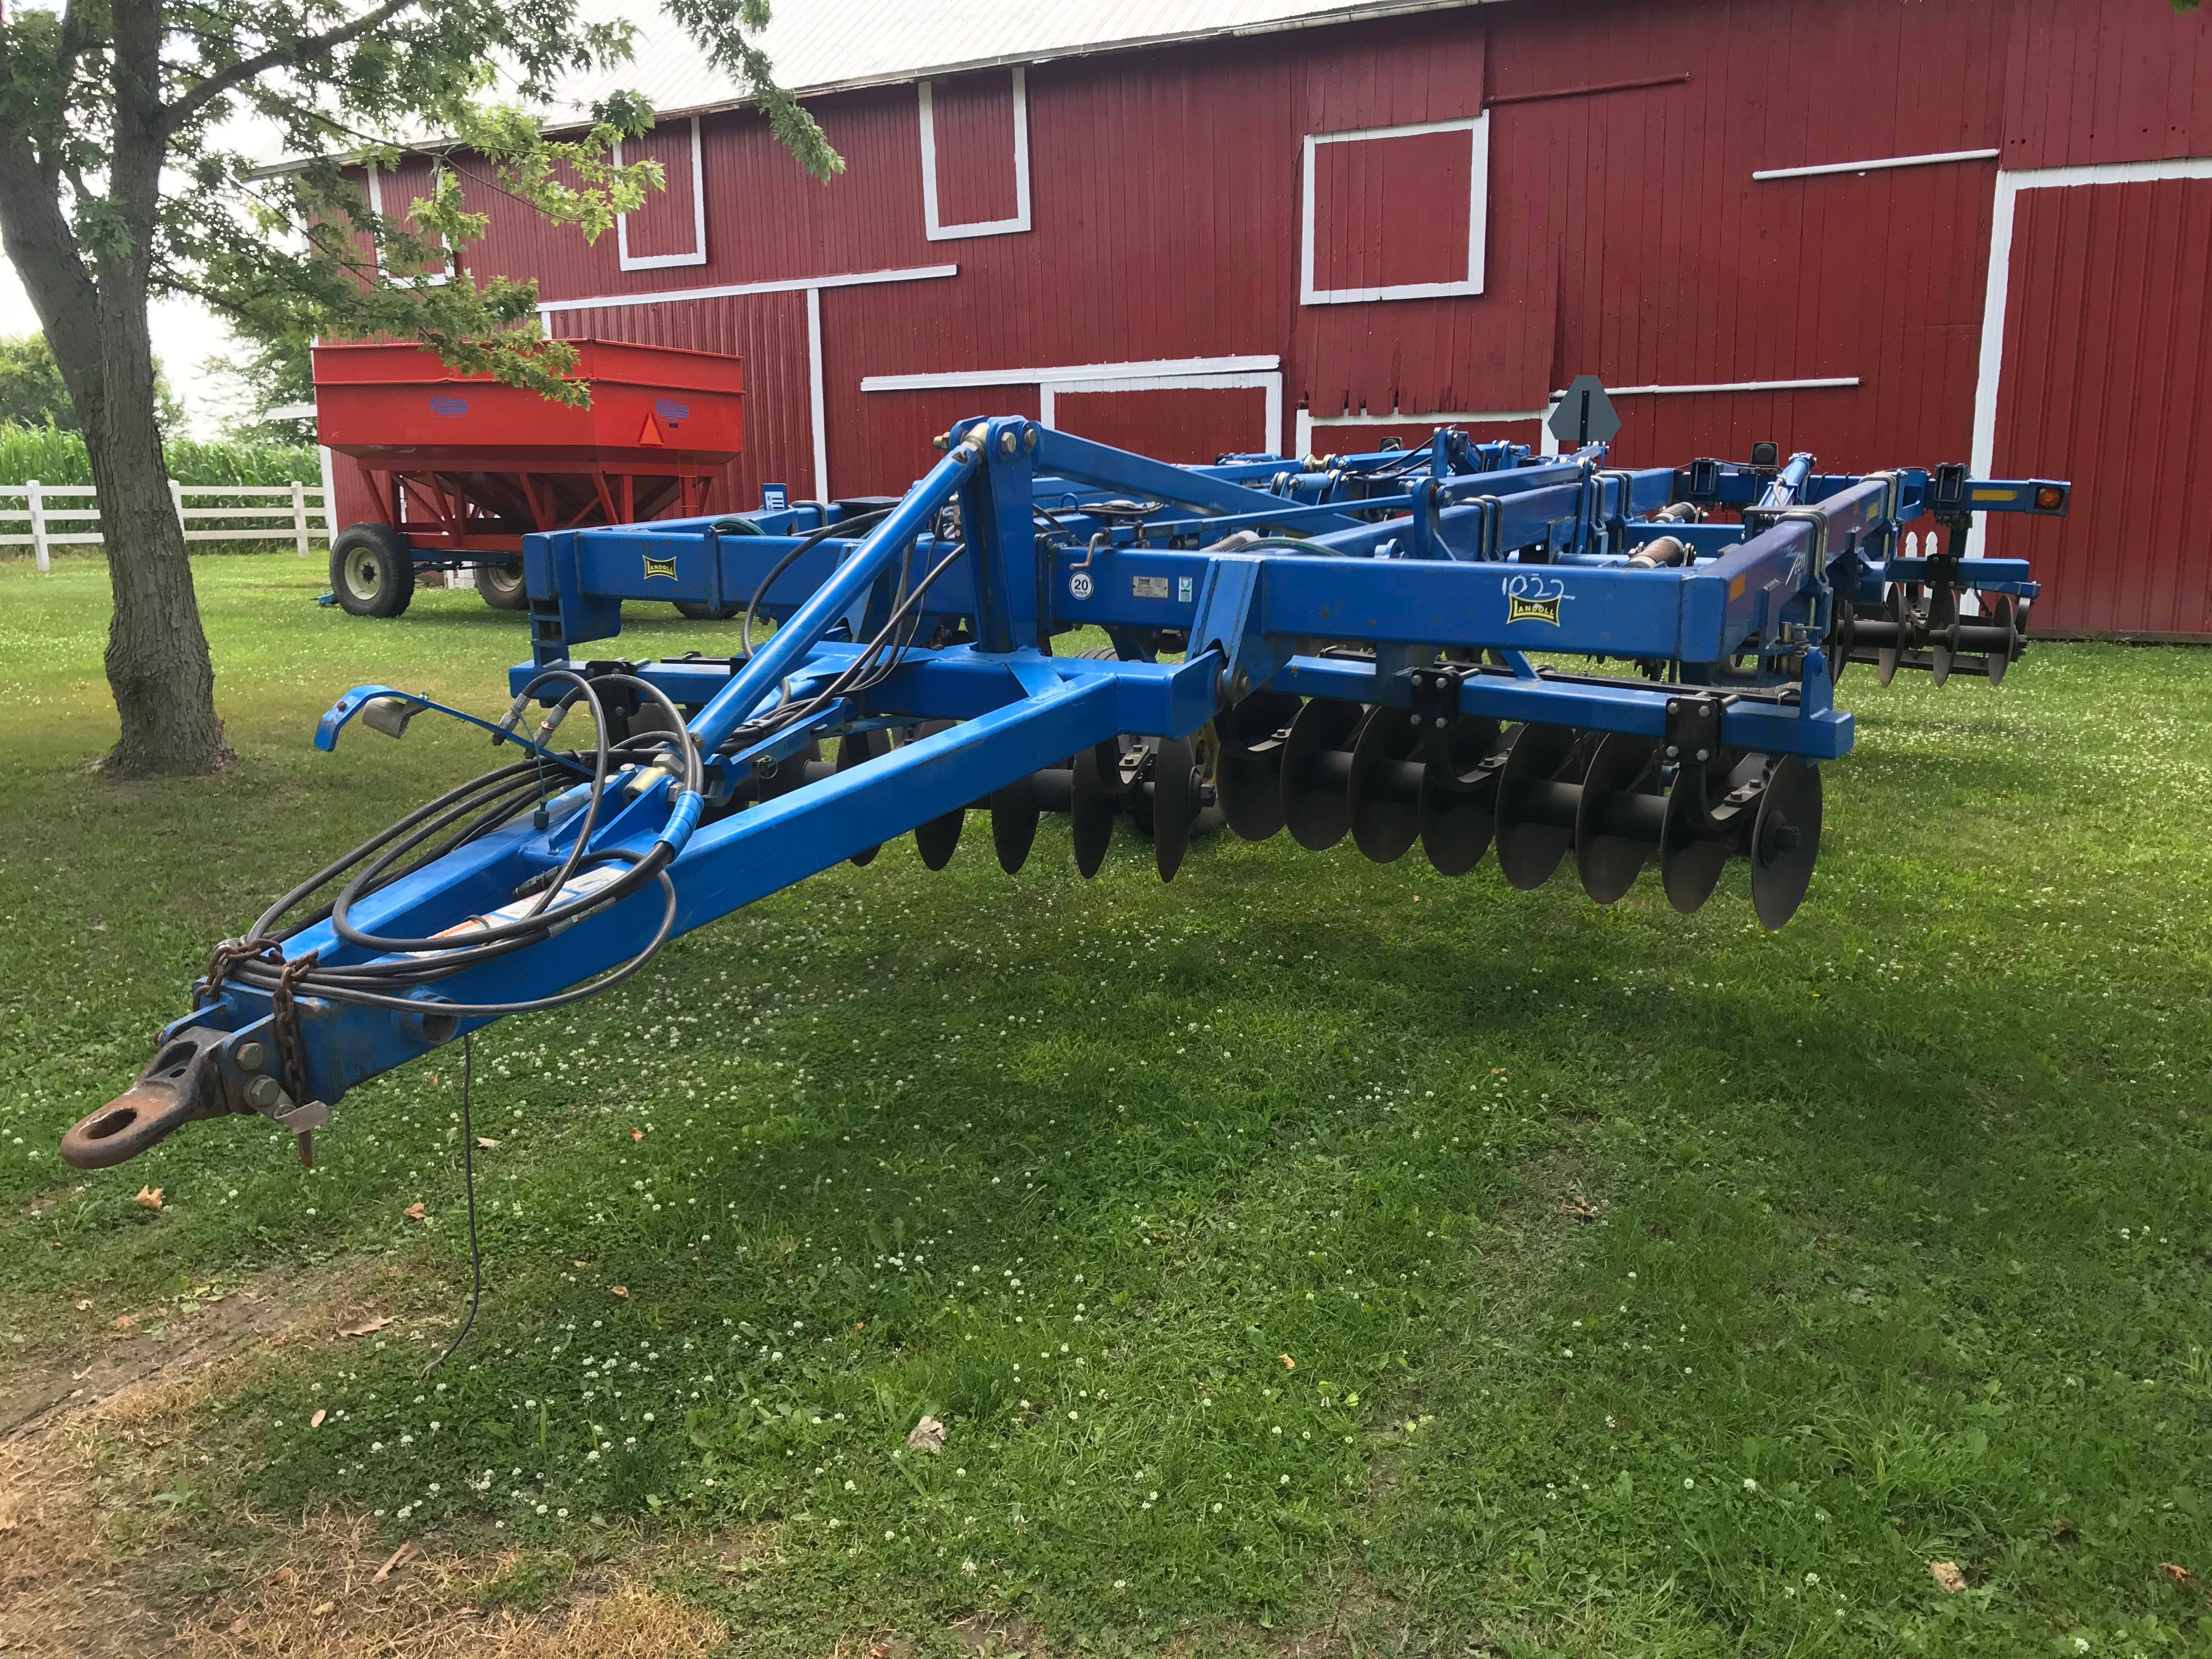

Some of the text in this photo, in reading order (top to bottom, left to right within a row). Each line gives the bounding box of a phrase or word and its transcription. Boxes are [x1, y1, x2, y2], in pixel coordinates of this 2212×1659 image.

[647, 560, 674, 575] LANDOLL
[1074, 579, 1088, 591] 20
[1513, 600, 1554, 620] LANDOLL
